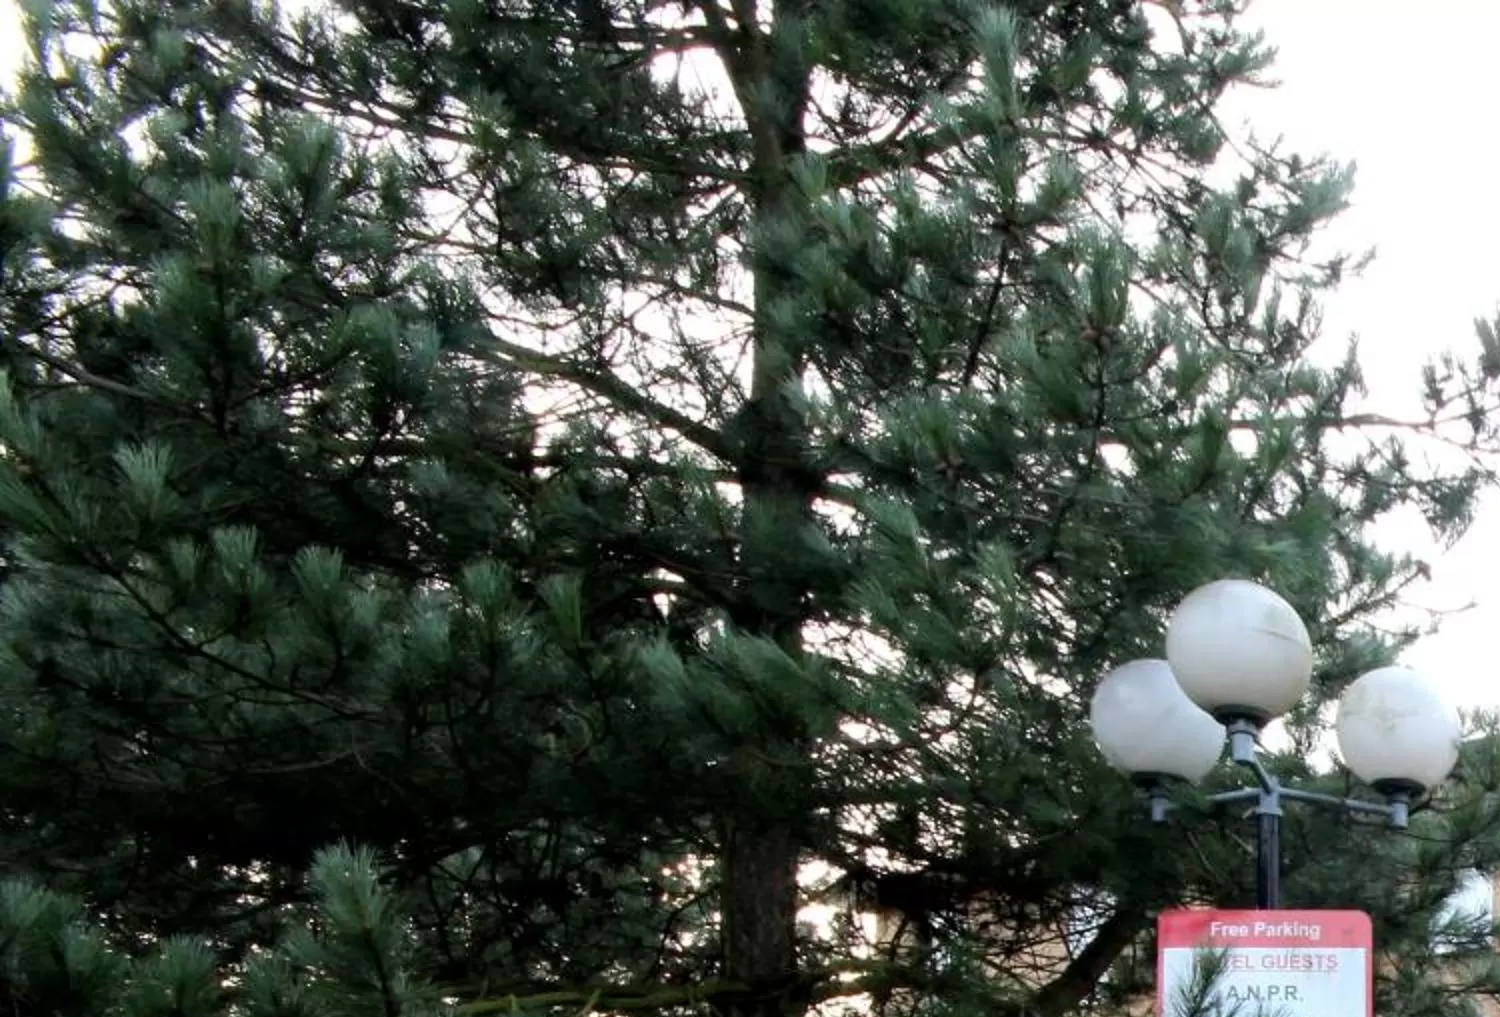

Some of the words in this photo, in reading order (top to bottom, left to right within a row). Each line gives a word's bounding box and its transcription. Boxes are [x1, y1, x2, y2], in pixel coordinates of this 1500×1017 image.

[1210, 921, 1249, 938] Free
[1253, 920, 1321, 940] Parking
[1261, 954, 1338, 970] GUESTS
[1226, 984, 1304, 1002] A.N.P.R.
